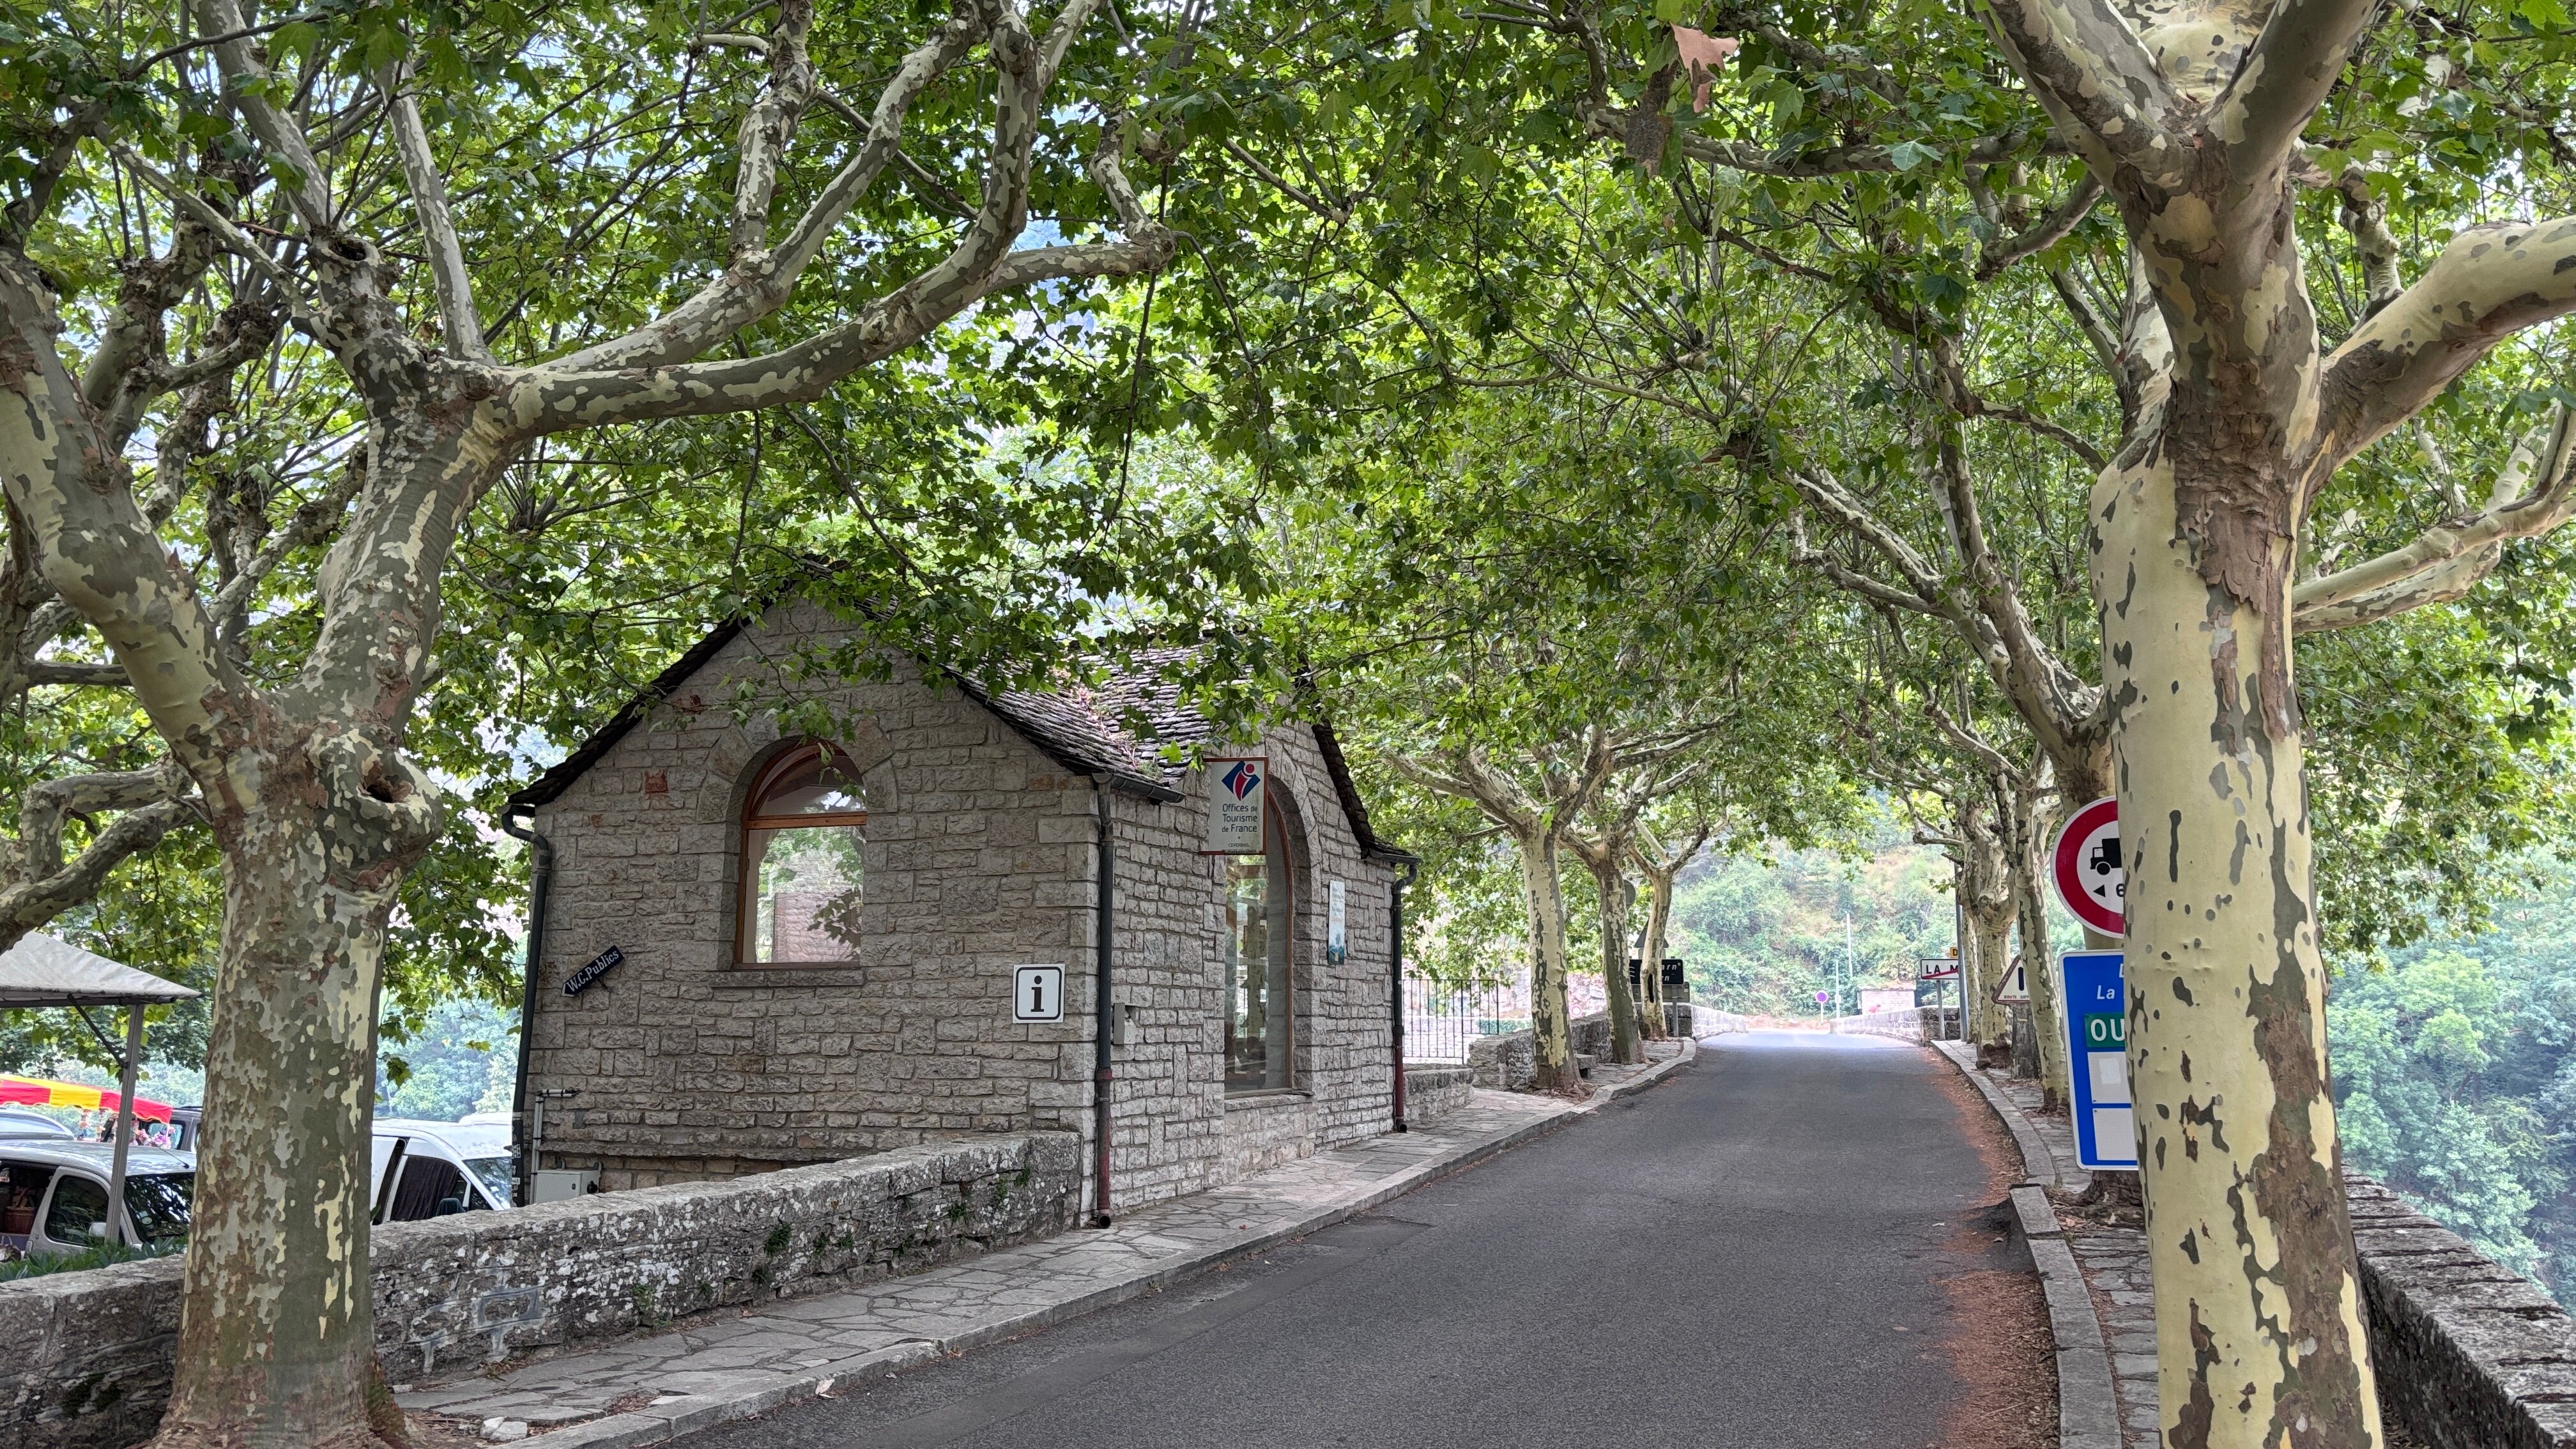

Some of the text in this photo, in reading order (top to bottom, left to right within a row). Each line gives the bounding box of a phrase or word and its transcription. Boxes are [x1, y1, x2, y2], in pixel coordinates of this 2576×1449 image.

[1222, 804, 1249, 812] Offices
[1222, 814, 1258, 822] Tourisme
[1230, 824, 1257, 832] France
[1926, 965, 1941, 974] LA
[2096, 985, 2115, 1000] La
